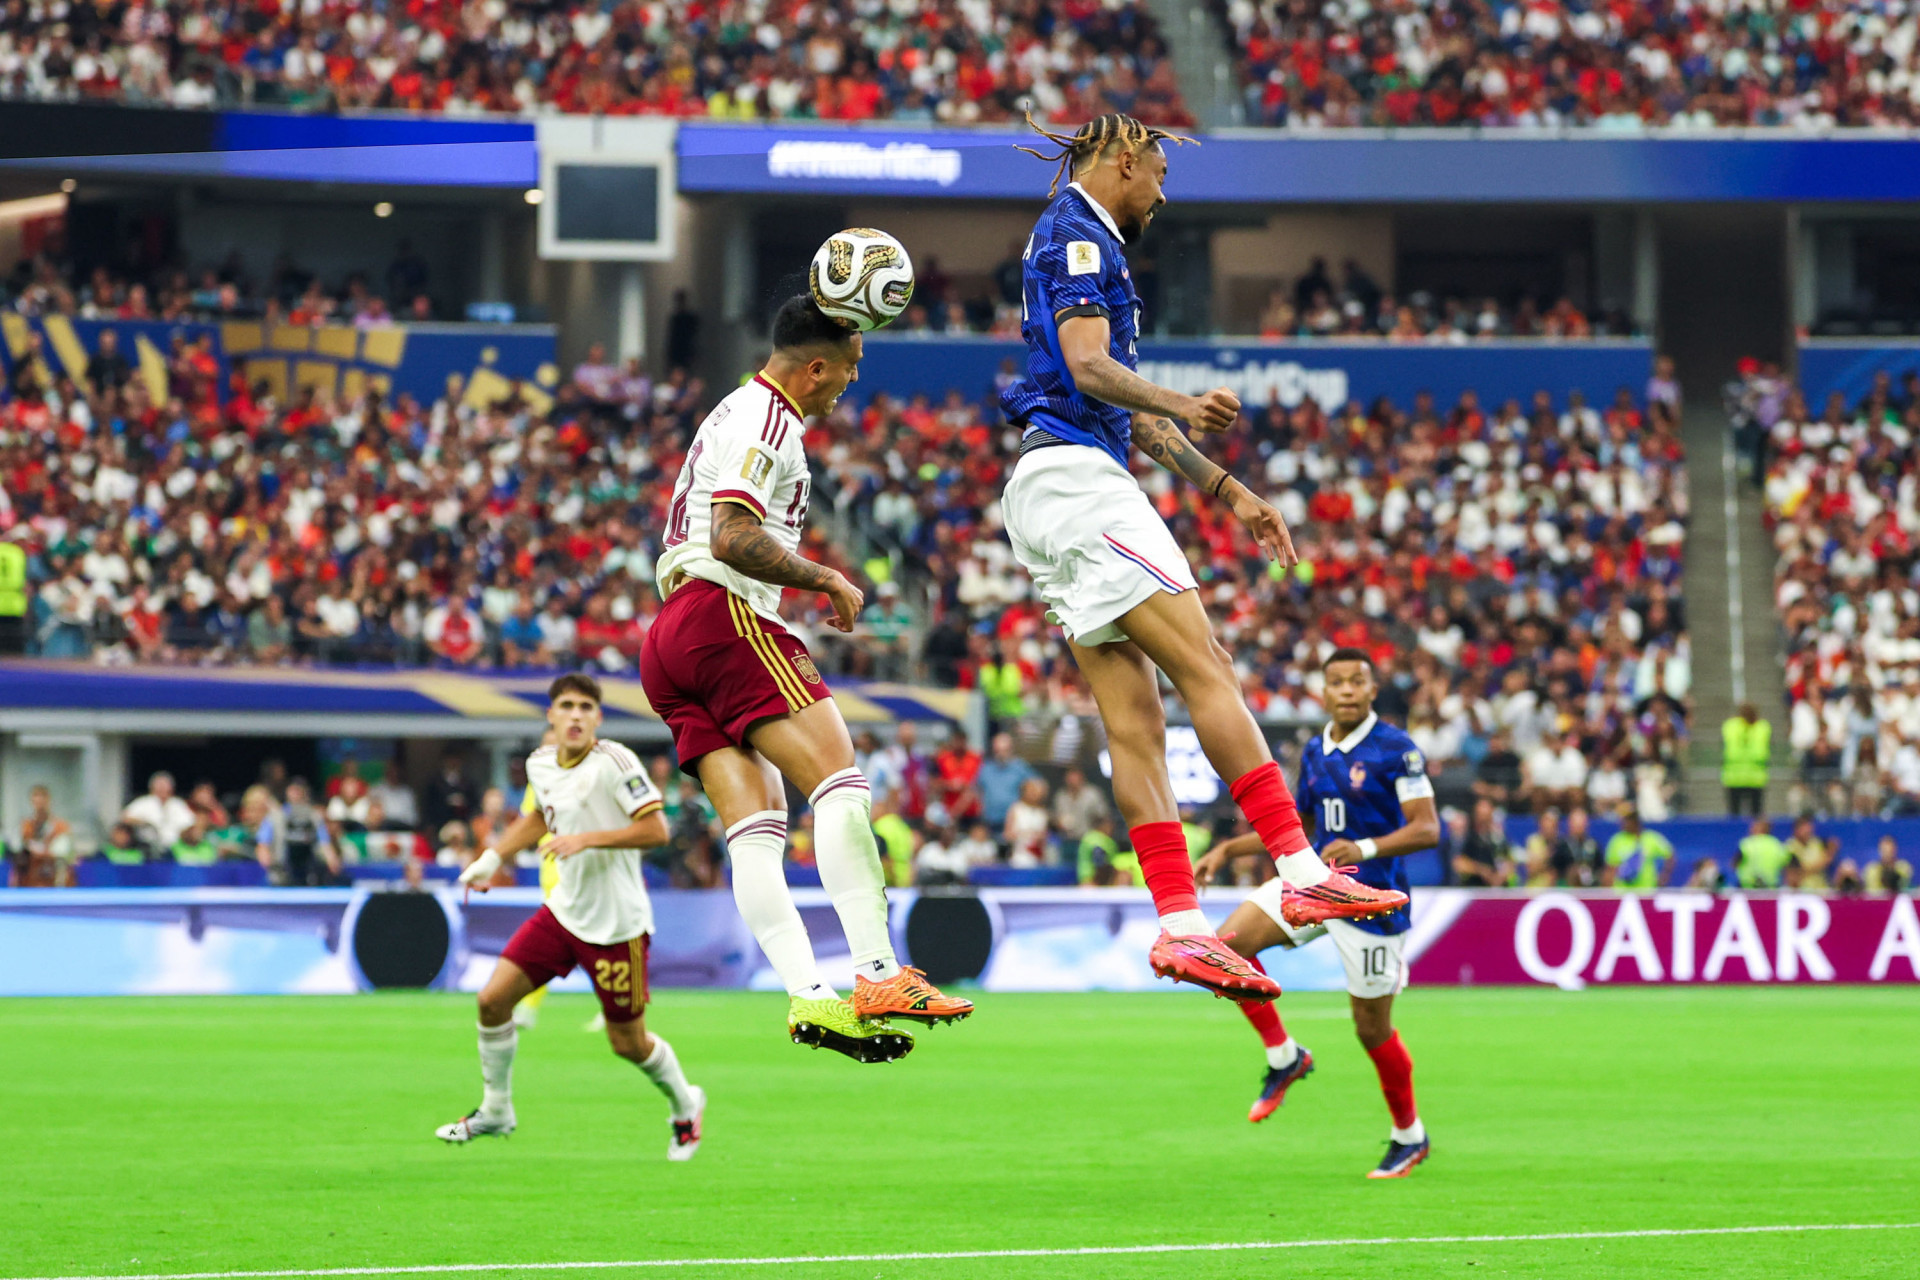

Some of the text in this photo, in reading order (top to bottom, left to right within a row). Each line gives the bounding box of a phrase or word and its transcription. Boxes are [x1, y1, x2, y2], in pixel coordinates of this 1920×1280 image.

[1323, 797, 1346, 832] 10
[1514, 891, 1836, 991] QATAR
[594, 958, 631, 993] 22
[1361, 945, 1386, 976] 10
